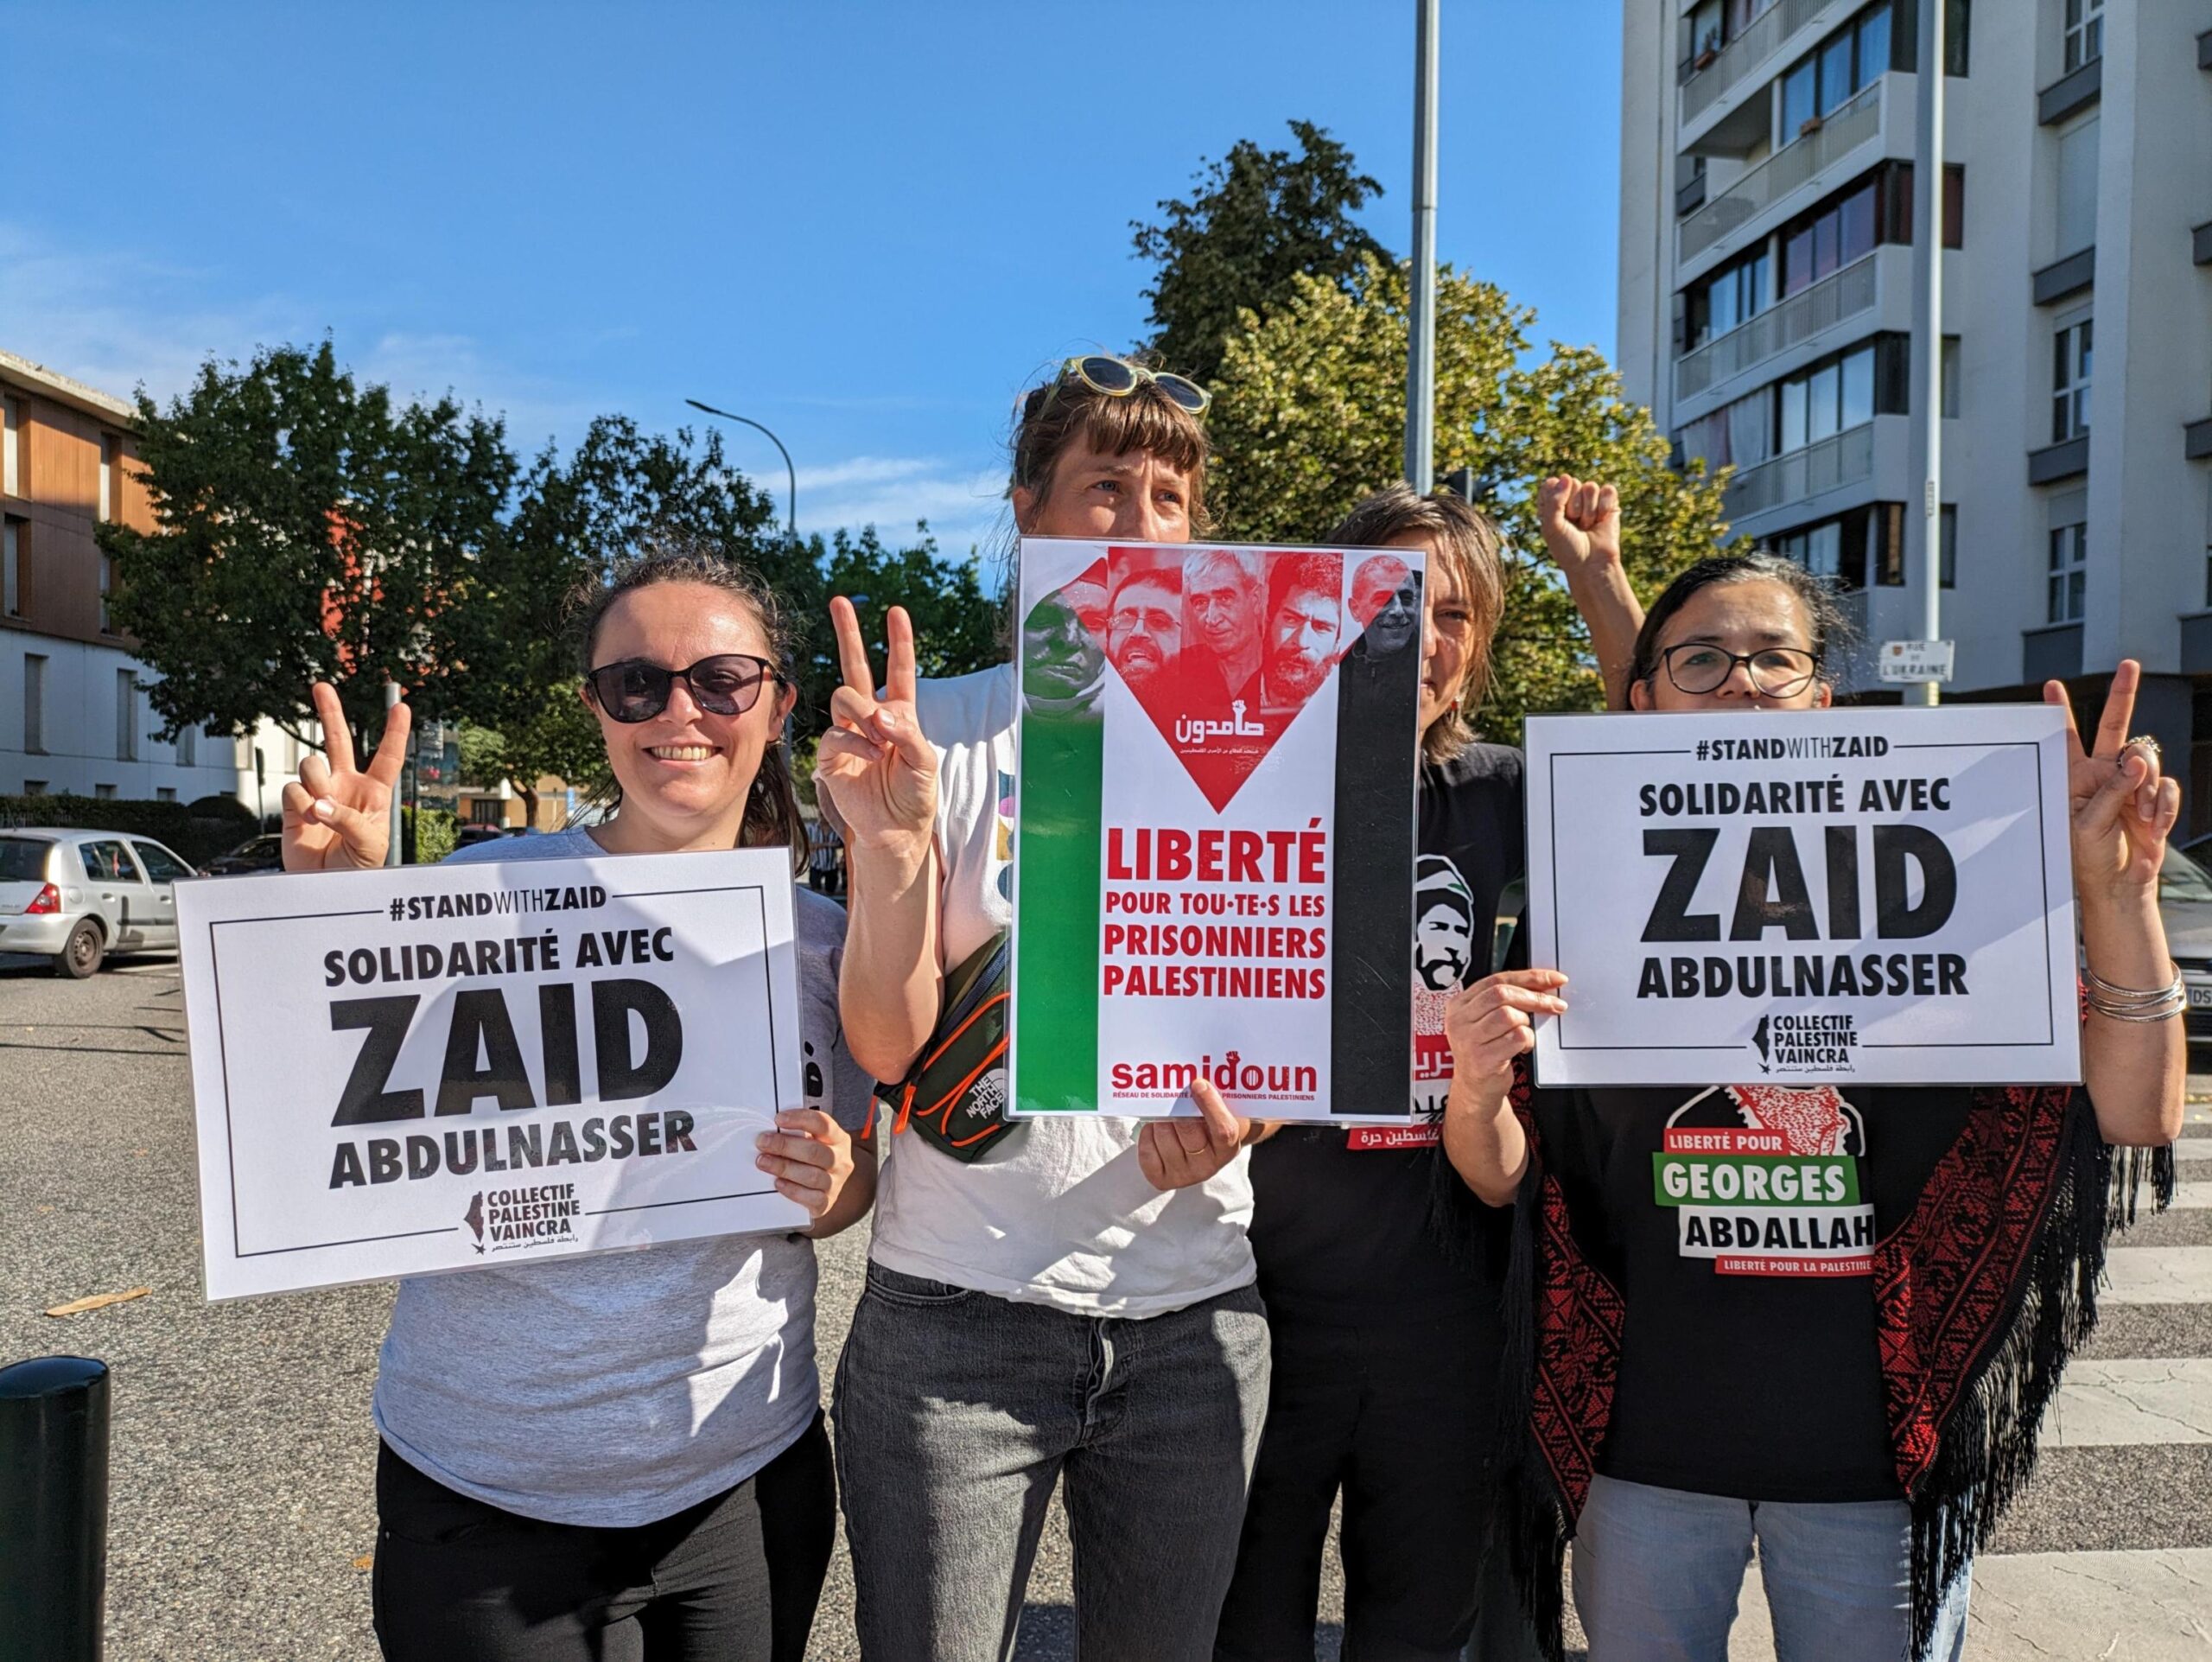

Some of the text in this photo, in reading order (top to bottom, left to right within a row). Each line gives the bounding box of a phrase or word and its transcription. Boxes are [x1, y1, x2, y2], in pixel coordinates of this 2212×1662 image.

[1176, 699, 1264, 743] صامدون
[1697, 735, 1889, 761] #STANDWITHZAID
[1639, 774, 1950, 816] SOLIDARITÉ AVEC
[1107, 818, 1325, 883] LIBERTÉ
[1640, 825, 1957, 943] ZAID
[389, 885, 607, 921] #STANDWITHZAID
[1105, 891, 1171, 914] POUR
[1289, 895, 1325, 917] LES
[324, 927, 674, 987] SOLIDARITÉ AVEC
[1104, 924, 1325, 958] PRISONNIERS
[1103, 965, 1325, 999] PALESTINIENS
[1637, 953, 1969, 999] ABDULNASSER
[1773, 1015, 1853, 1030] COLLECTIF
[1774, 1032, 1858, 1047] PALESTINE
[330, 977, 683, 1127] ZAID
[1775, 1048, 1849, 1063] VAINCRA
[969, 1075, 992, 1097] THE
[1111, 1051, 1317, 1092] samidoun
[966, 1083, 998, 1118] NORTH
[979, 1092, 1004, 1119] FACE
[329, 1111, 697, 1190] ABDULNASSER
[1361, 1130, 1382, 1146] حرة
[1669, 1131, 1783, 1150] LIBERTÉ POUR
[487, 1183, 574, 1207] COLLECTIF
[1662, 1162, 1846, 1201] GEORGES
[489, 1200, 580, 1224] PALESTINE
[490, 1218, 571, 1242] VAINCRA
[1685, 1214, 1874, 1249] ABDALLAH
[1724, 1258, 1872, 1272] LIBERTÉ POUR LA PALESTINE
